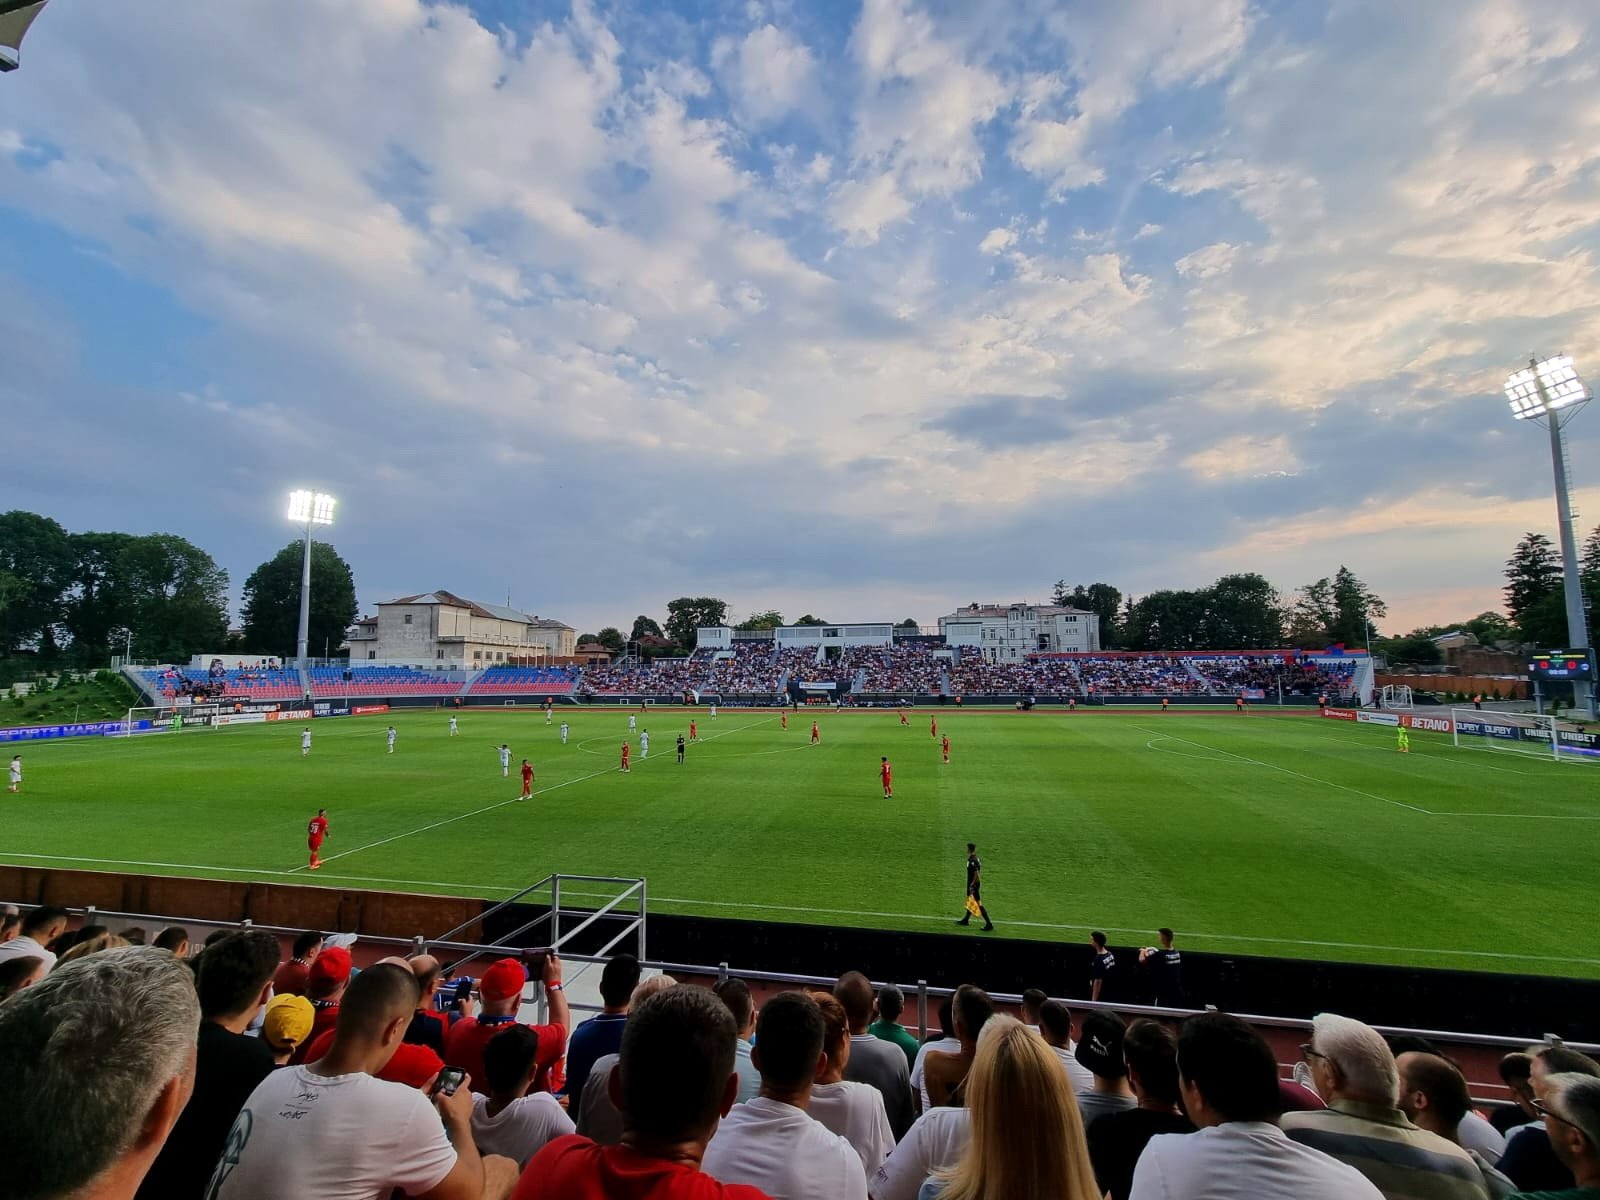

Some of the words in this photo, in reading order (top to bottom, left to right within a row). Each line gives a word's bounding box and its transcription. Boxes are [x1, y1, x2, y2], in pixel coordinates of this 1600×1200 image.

[278, 710, 310, 720] BETANO
[1411, 717, 1450, 731] BETANO
[1561, 731, 1597, 742] UNIBET
